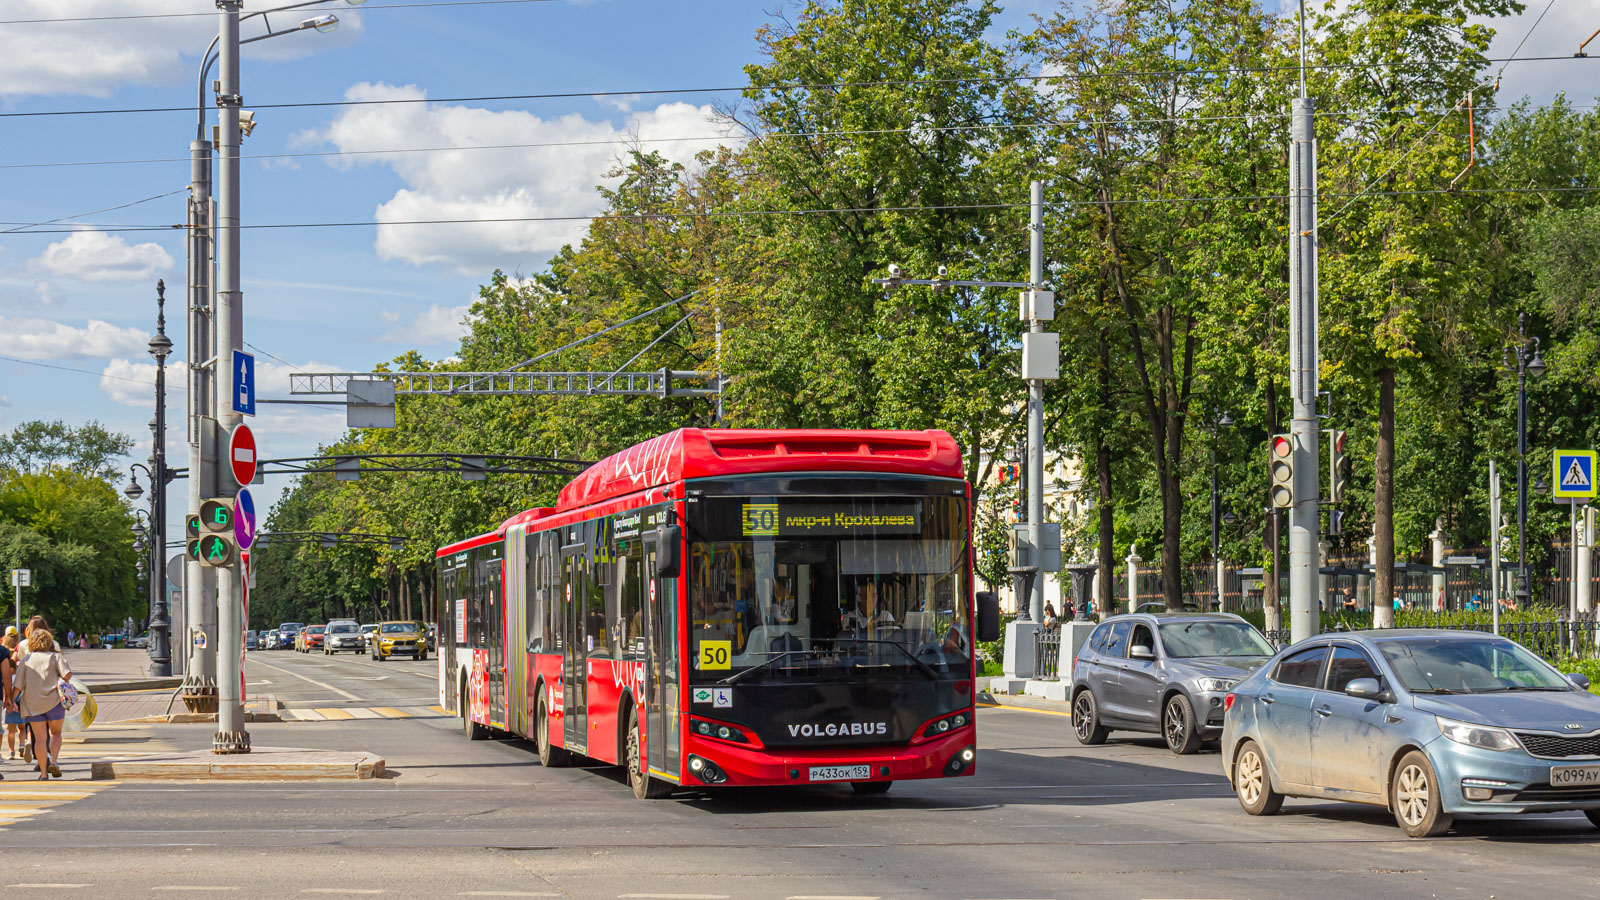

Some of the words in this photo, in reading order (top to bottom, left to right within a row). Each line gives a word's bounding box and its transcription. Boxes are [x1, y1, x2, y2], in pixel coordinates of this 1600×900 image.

[215, 507, 227, 524] 16
[745, 508, 774, 531] 50
[785, 515, 831, 528] мкр-н
[834, 512, 915, 528] Крохалева
[703, 647, 727, 665] 50
[788, 722, 887, 737] VOLGABUS
[852, 766, 868, 775] 159
